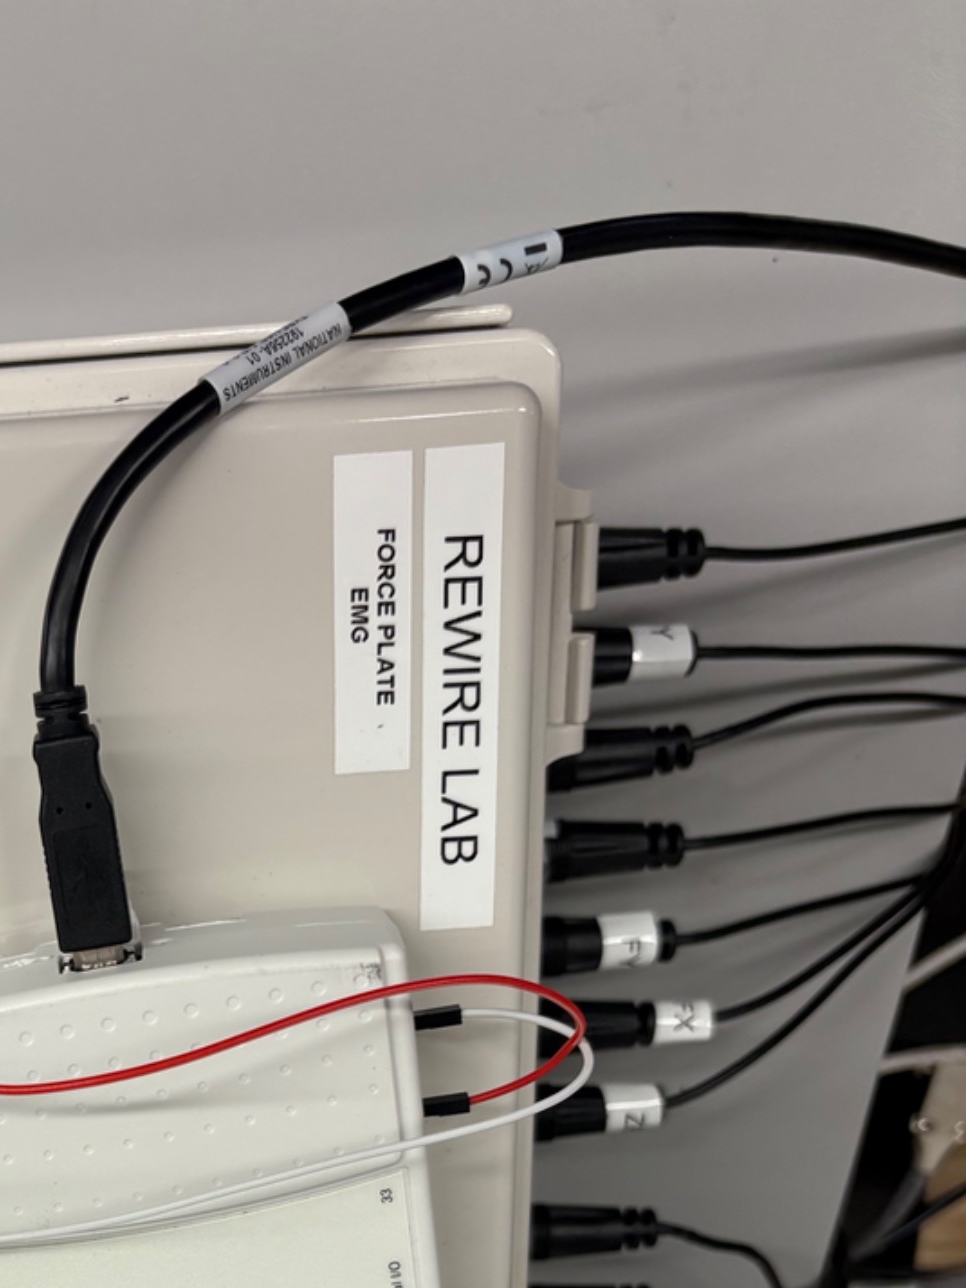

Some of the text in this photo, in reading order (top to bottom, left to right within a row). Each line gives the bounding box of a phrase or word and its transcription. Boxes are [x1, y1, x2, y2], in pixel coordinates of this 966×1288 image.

[295, 323, 343, 360] NATIONAL
[222, 355, 292, 401] INSTRUMENTS
[350, 587, 369, 644] EMG
[376, 528, 395, 706] FORCE PLATE
[440, 535, 484, 866] REWIRE LAB
[380, 1188, 393, 1203] 33
[388, 1260, 401, 1279] I/O
